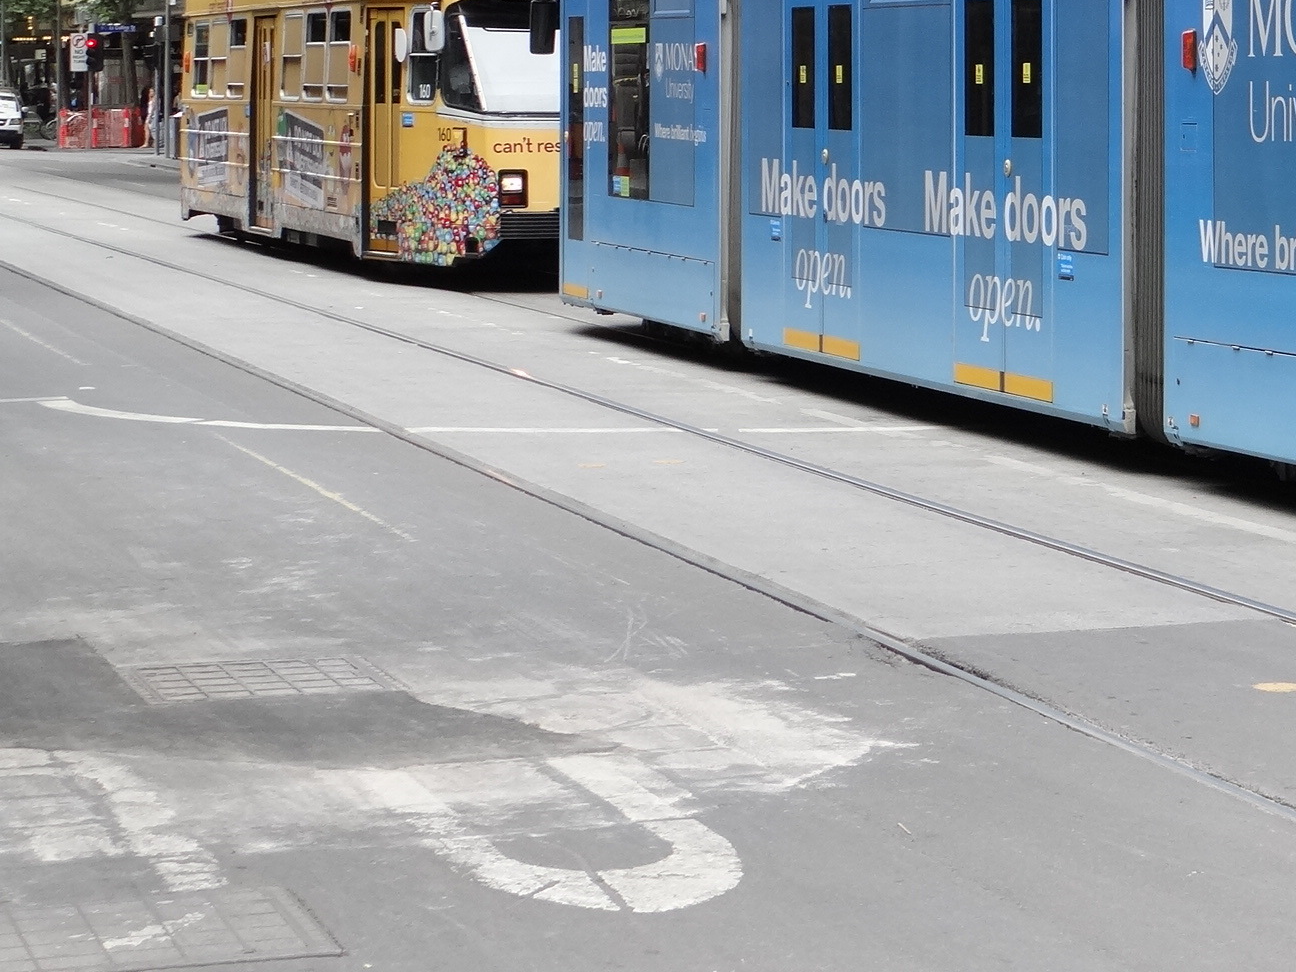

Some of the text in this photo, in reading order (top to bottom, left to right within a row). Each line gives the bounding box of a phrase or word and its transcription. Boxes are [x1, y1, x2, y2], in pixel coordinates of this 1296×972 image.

[583, 44, 607, 73] Make
[419, 83, 431, 99] 160
[583, 81, 608, 108] doors
[437, 128, 451, 142] 160
[493, 137, 533, 154] can't
[583, 121, 606, 149] open.
[761, 157, 886, 227] Make doors
[924, 170, 1087, 251] Make doors
[1199, 218, 1269, 270] Where
[795, 248, 852, 309] open.
[969, 273, 1041, 343] open.
